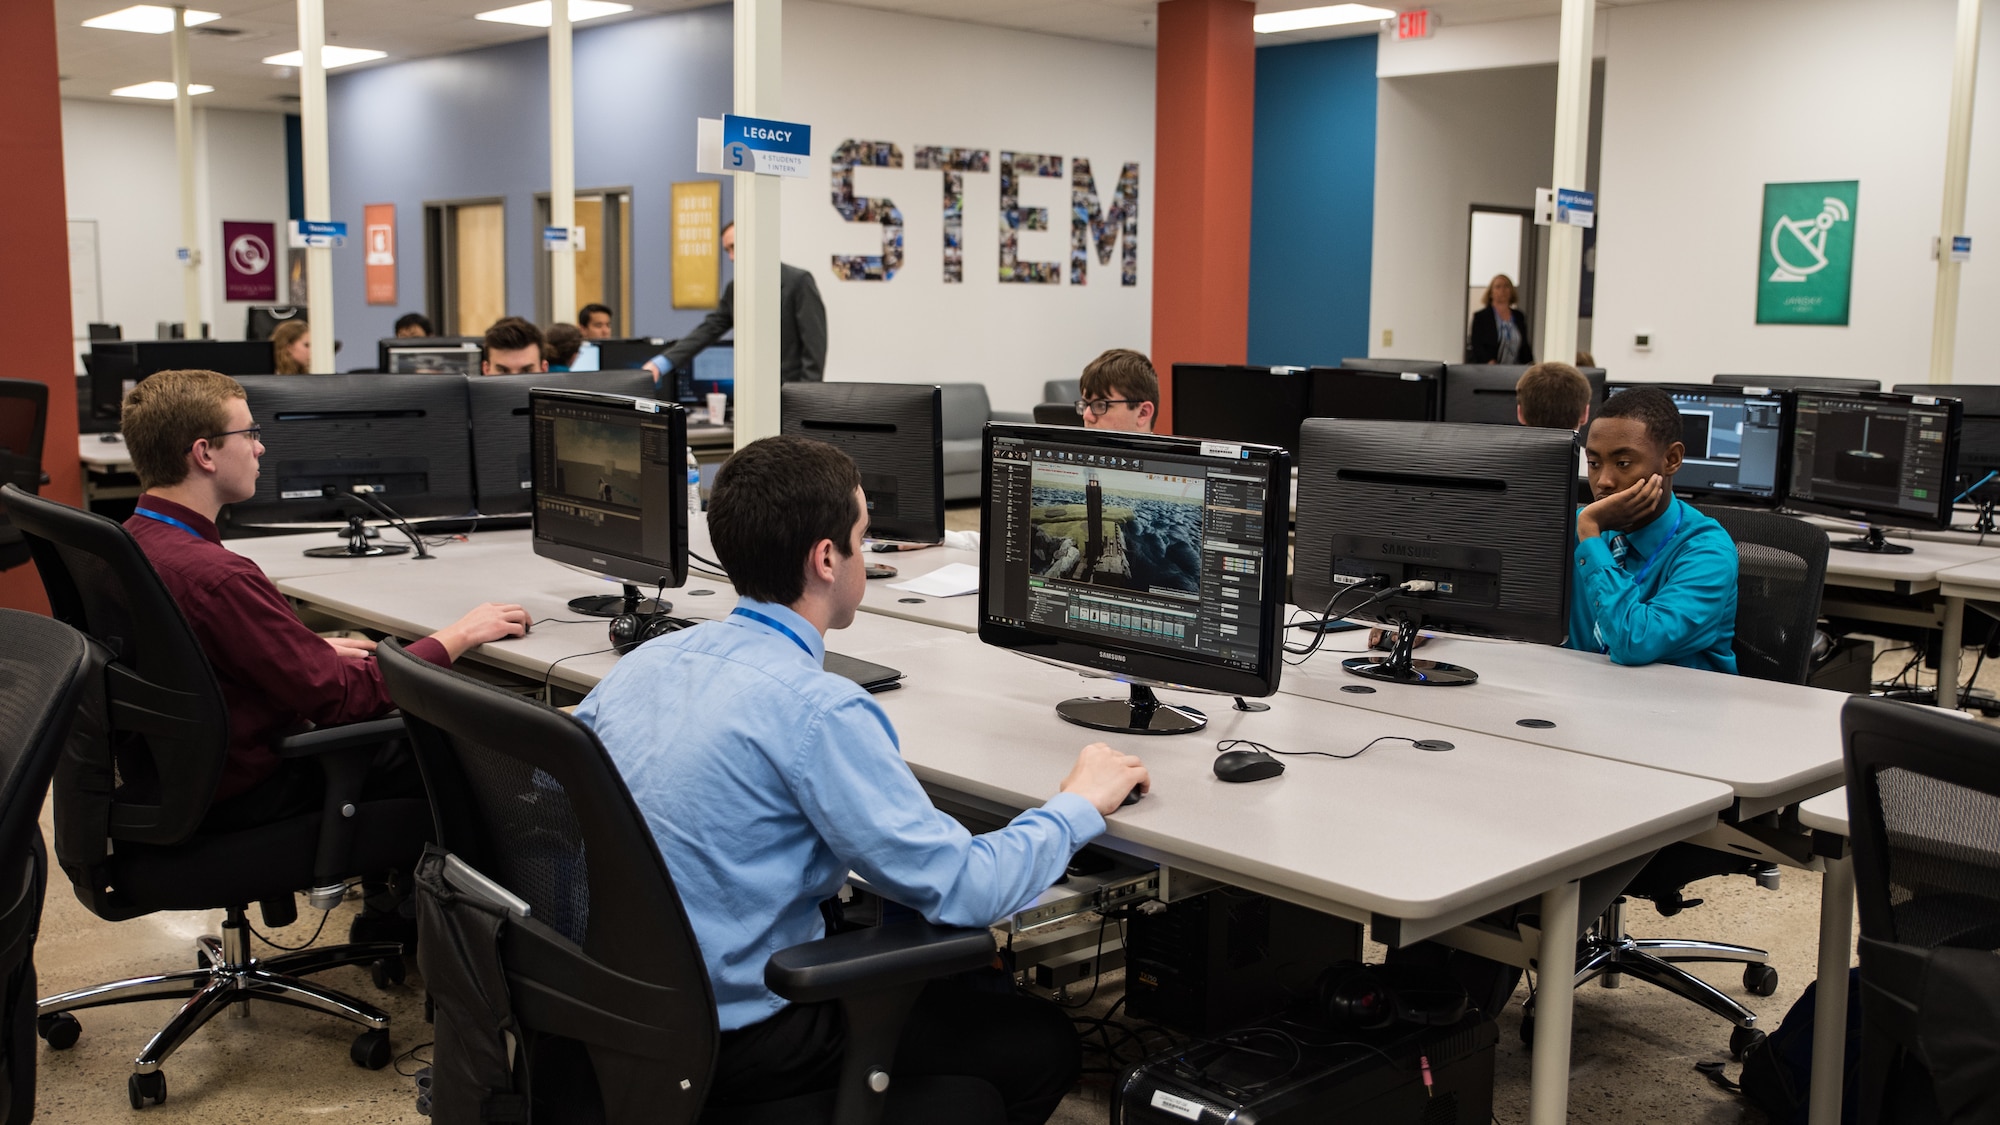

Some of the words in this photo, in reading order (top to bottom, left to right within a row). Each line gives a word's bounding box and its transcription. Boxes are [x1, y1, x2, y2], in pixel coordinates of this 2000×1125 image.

[1399, 9, 1428, 39] EXIT
[743, 126, 792, 142] LEGACY
[732, 146, 743, 166] 5
[768, 155, 802, 164] STUDENTS
[830, 139, 1140, 286] STEM
[1382, 543, 1440, 560] SAMSUNG
[1099, 651, 1127, 662] SAMSUNG
